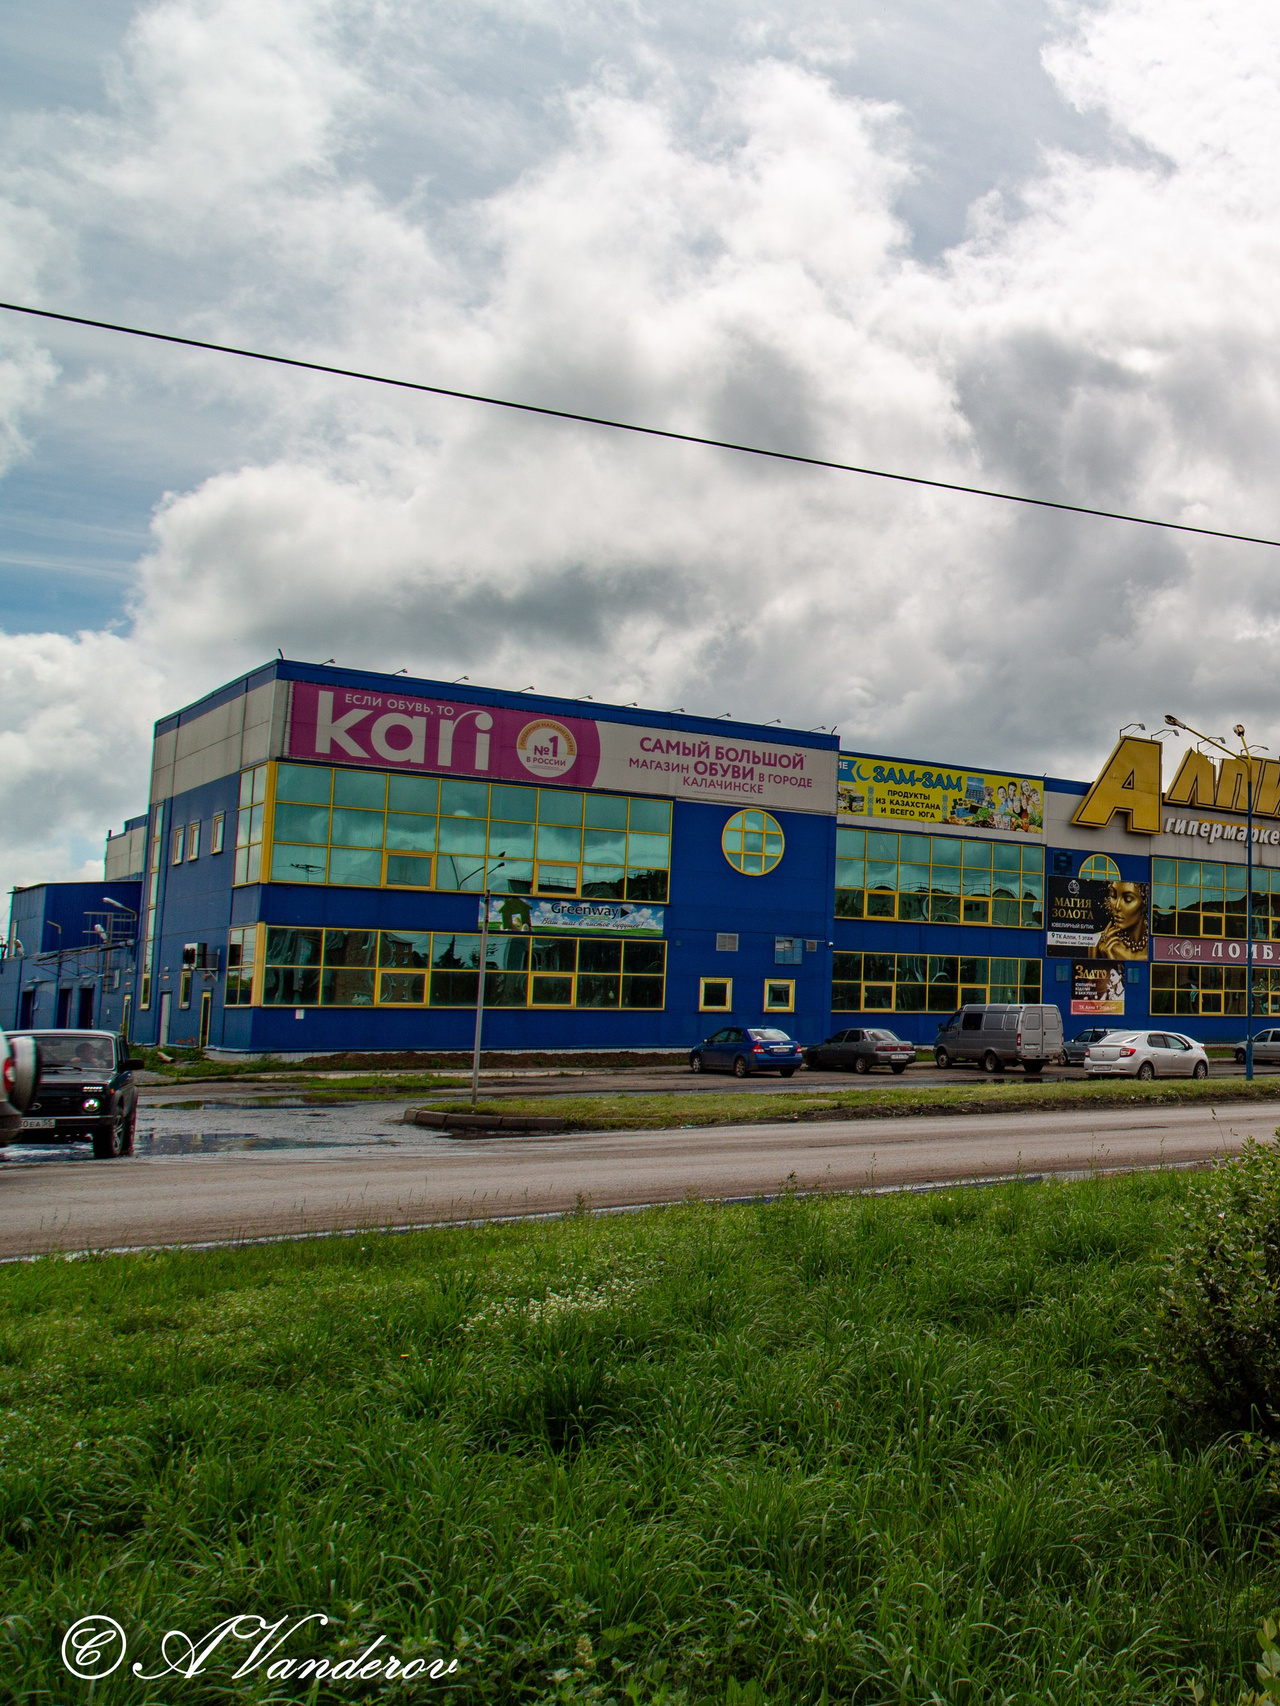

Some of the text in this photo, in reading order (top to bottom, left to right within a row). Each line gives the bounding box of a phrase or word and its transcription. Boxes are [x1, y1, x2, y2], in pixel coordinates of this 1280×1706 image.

[345, 693, 454, 716] ЕСЛИ ОБУВЬ, ТО
[315, 690, 494, 771] kari
[533, 735, 559, 758] №1
[639, 736, 710, 759] САМЫЙ
[533, 757, 566, 767] РОССИИ
[629, 758, 813, 789] МАГАЗИН ОБУВИ В ГОРОДЕ
[872, 765, 963, 793] ЗАМ-ЗАМ
[683, 776, 764, 795] КАЛАЧИНСКЕ
[887, 789, 930, 800] ПРОДУКТЫ
[876, 797, 941, 810] ИЗ КАЗАХСТАНА
[890, 808, 915, 817] ВСЕГО
[918, 811, 936, 819] ЮГА
[551, 902, 619, 920] Greenway
[1054, 896, 1092, 909] МАГИЯ
[541, 917, 559, 925] Ваш
[586, 920, 611, 928] чистое
[1052, 908, 1094, 920] ЗОЛОТА
